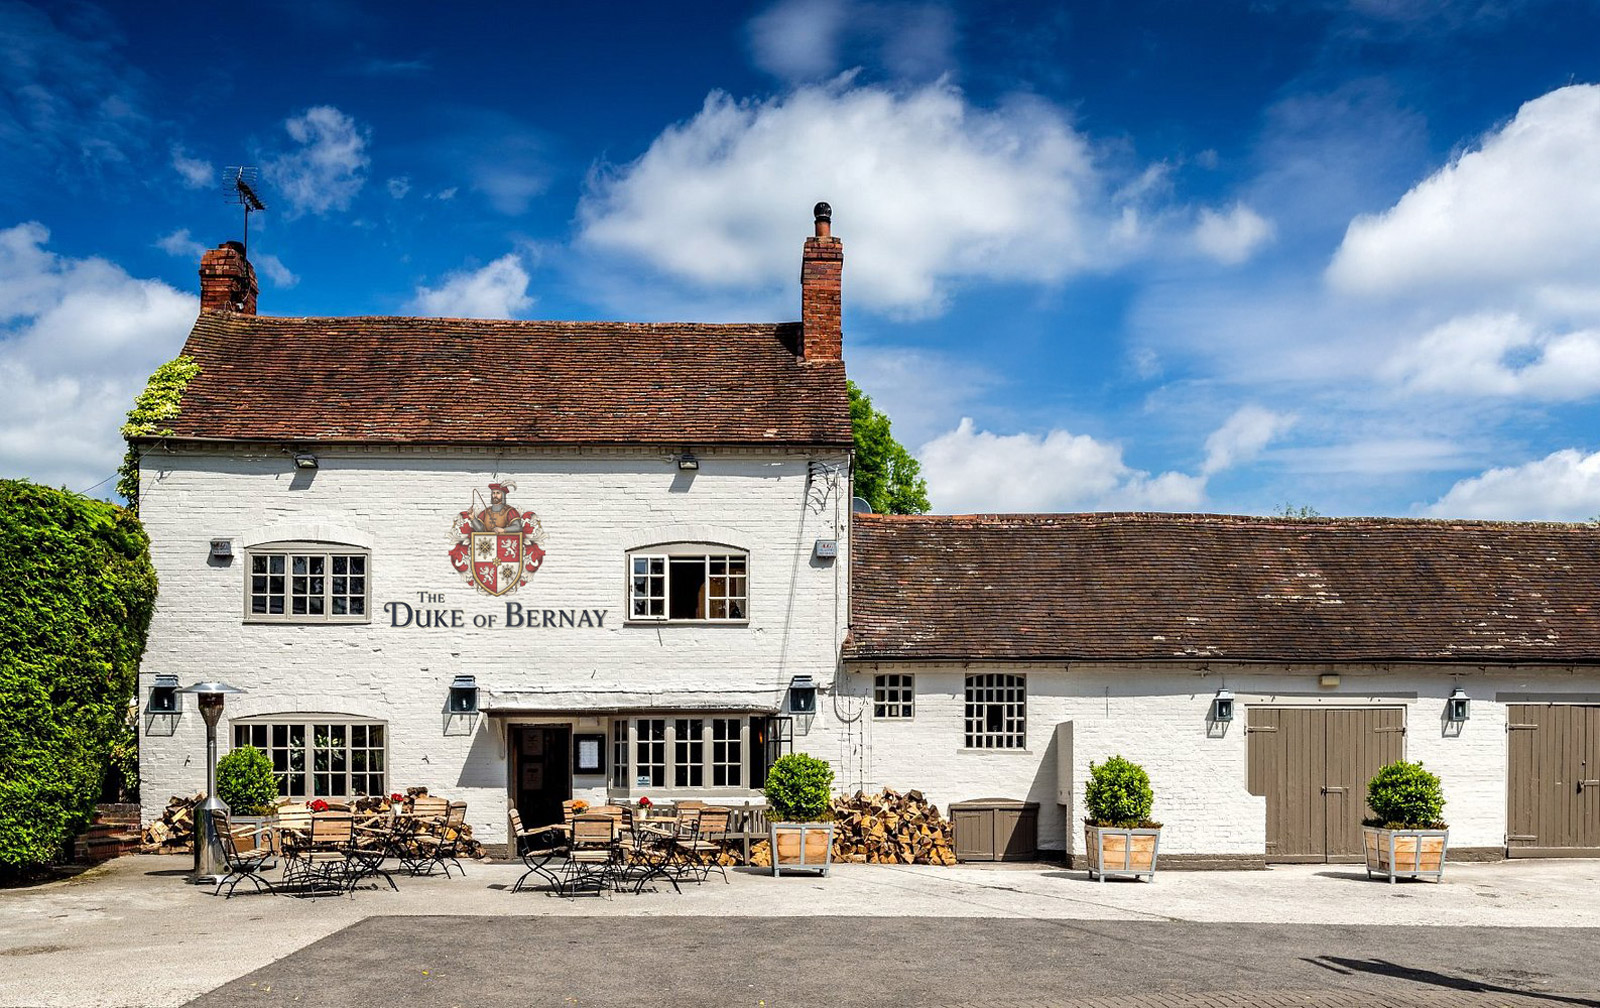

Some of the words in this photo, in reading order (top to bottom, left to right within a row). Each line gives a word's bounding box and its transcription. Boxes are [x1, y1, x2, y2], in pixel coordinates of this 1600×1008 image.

[416, 591, 446, 604] THE
[383, 601, 465, 628] DUKE
[473, 614, 498, 628] OF
[505, 601, 609, 628] BERNAY
